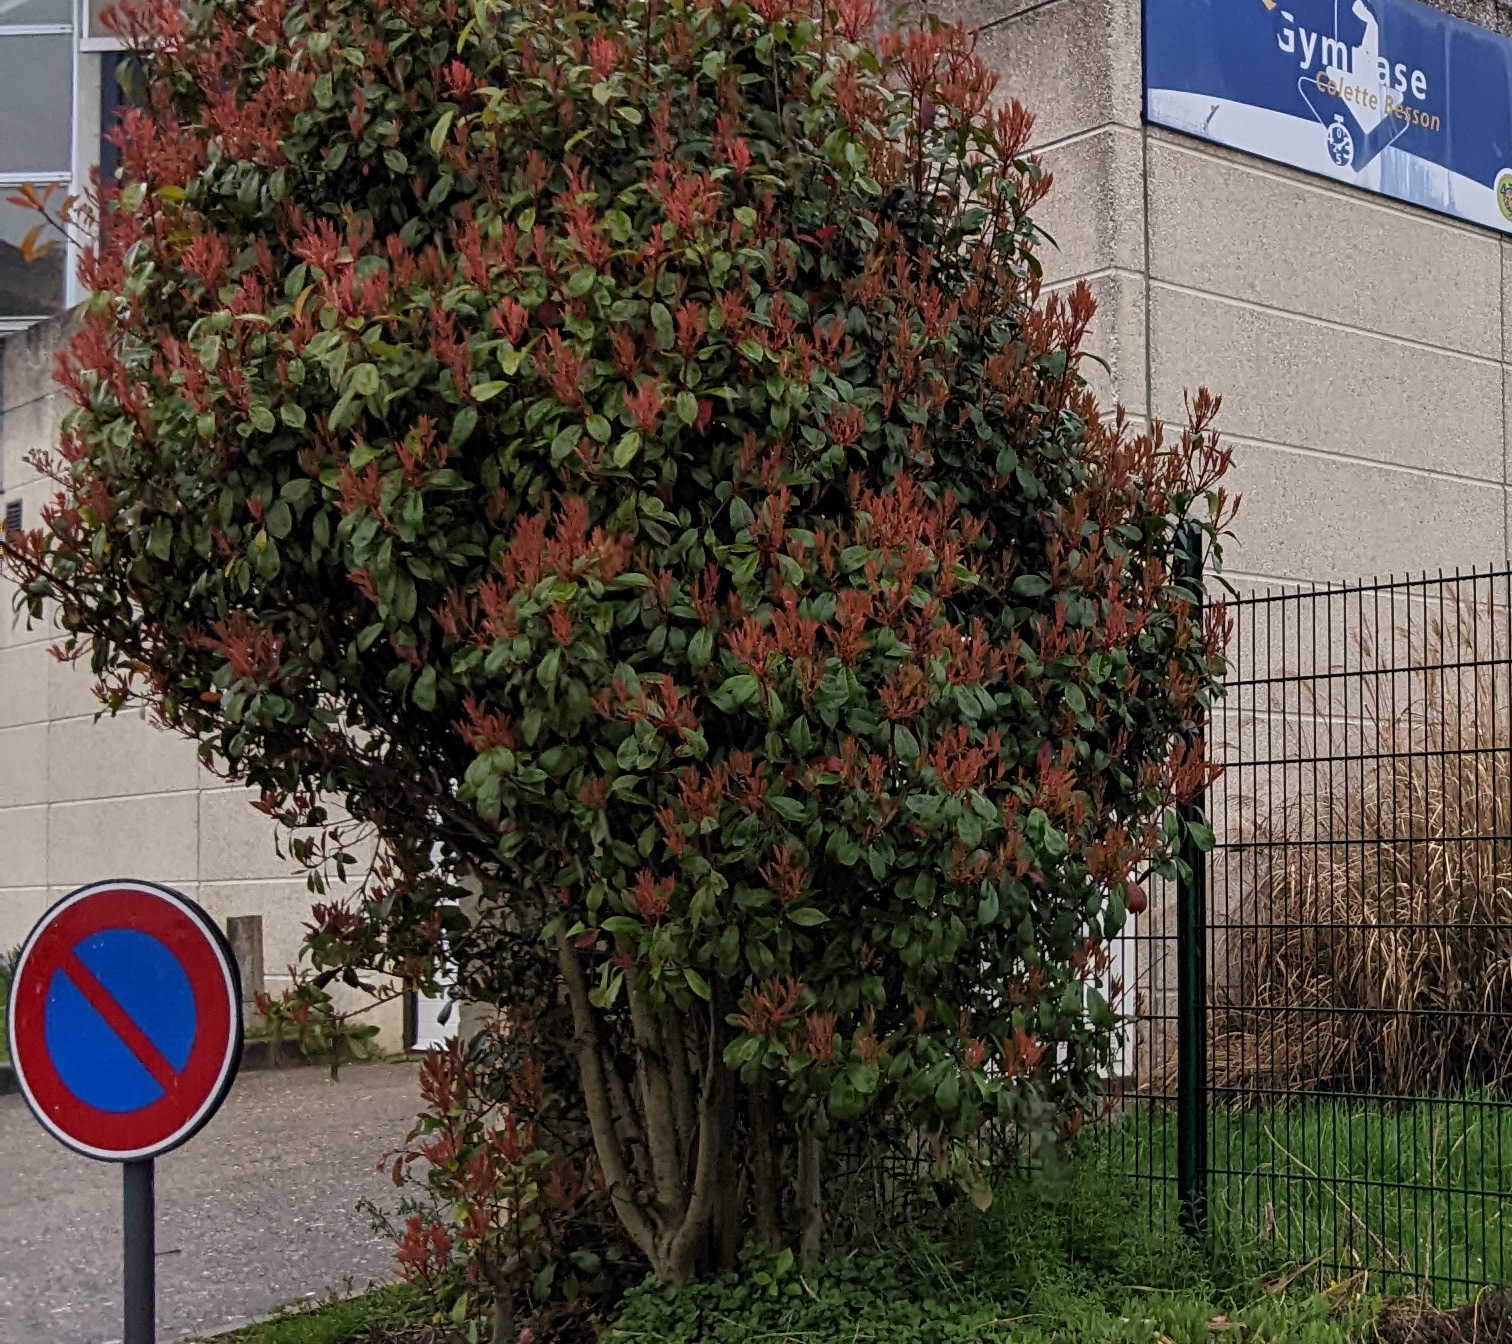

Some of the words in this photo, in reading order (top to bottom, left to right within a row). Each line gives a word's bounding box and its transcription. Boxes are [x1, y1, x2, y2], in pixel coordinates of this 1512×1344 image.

[1276, 10, 1428, 100] Gymase
[1315, 71, 1378, 110] Colette
[1384, 94, 1441, 132] Besson
